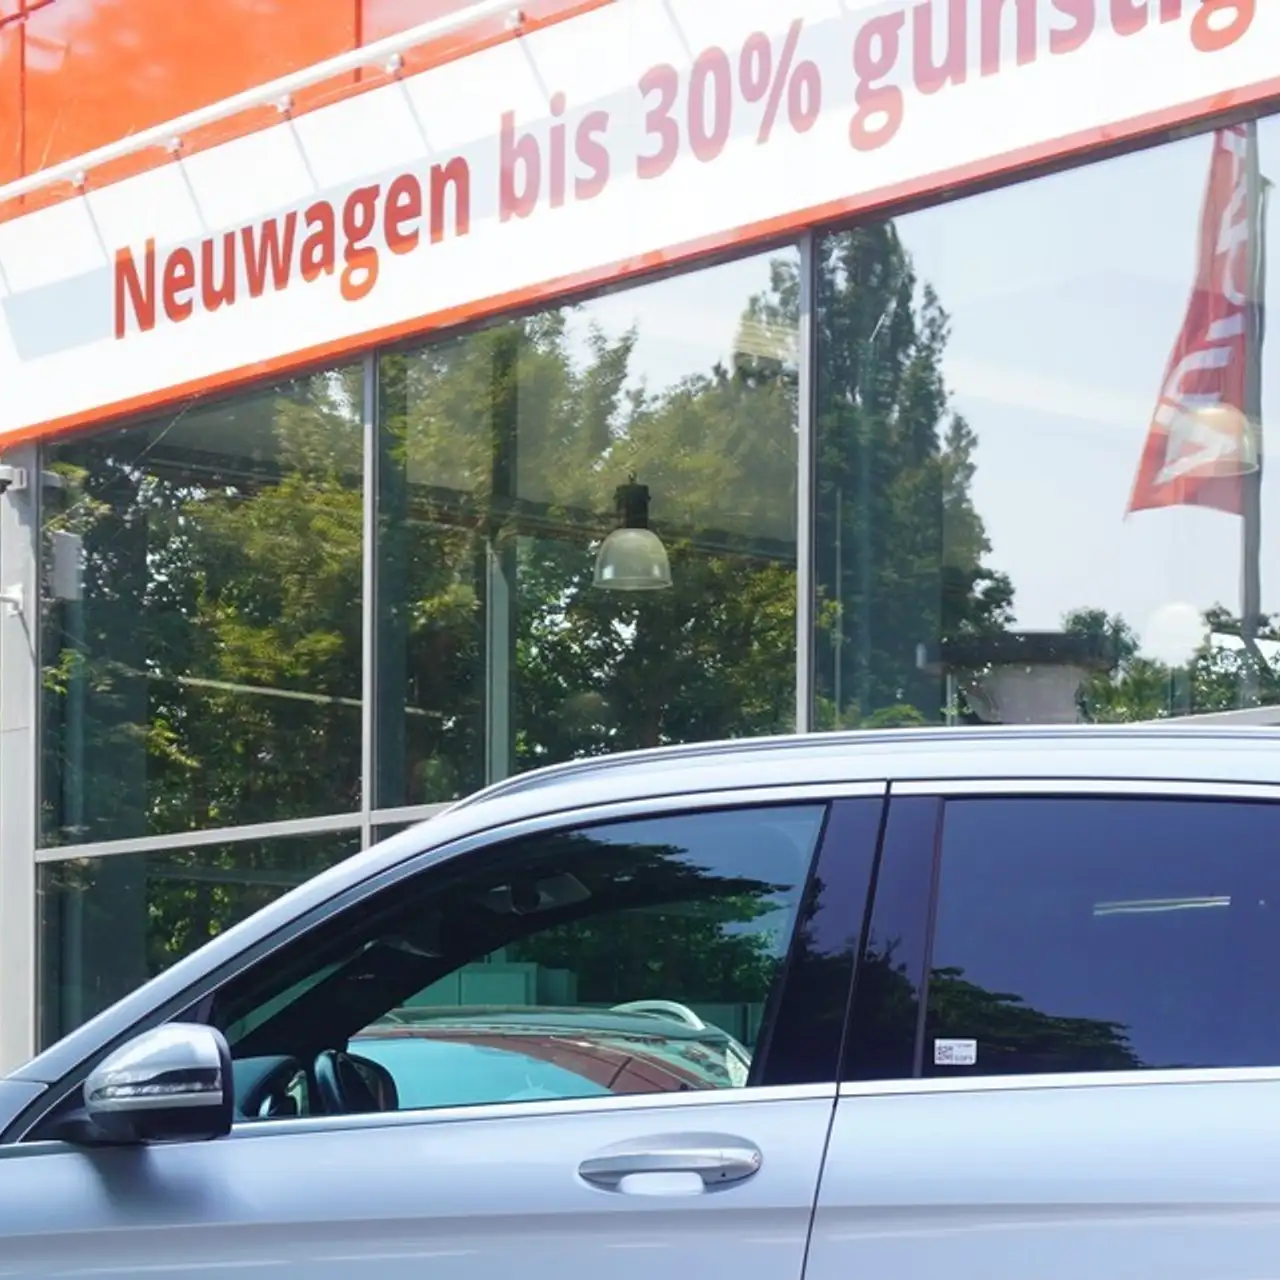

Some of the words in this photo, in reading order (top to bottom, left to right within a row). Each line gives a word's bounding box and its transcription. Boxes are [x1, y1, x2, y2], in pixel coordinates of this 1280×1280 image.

[113, 154, 471, 341] Neuwagen
[498, 92, 610, 222] bis
[635, 18, 823, 181] 30%
